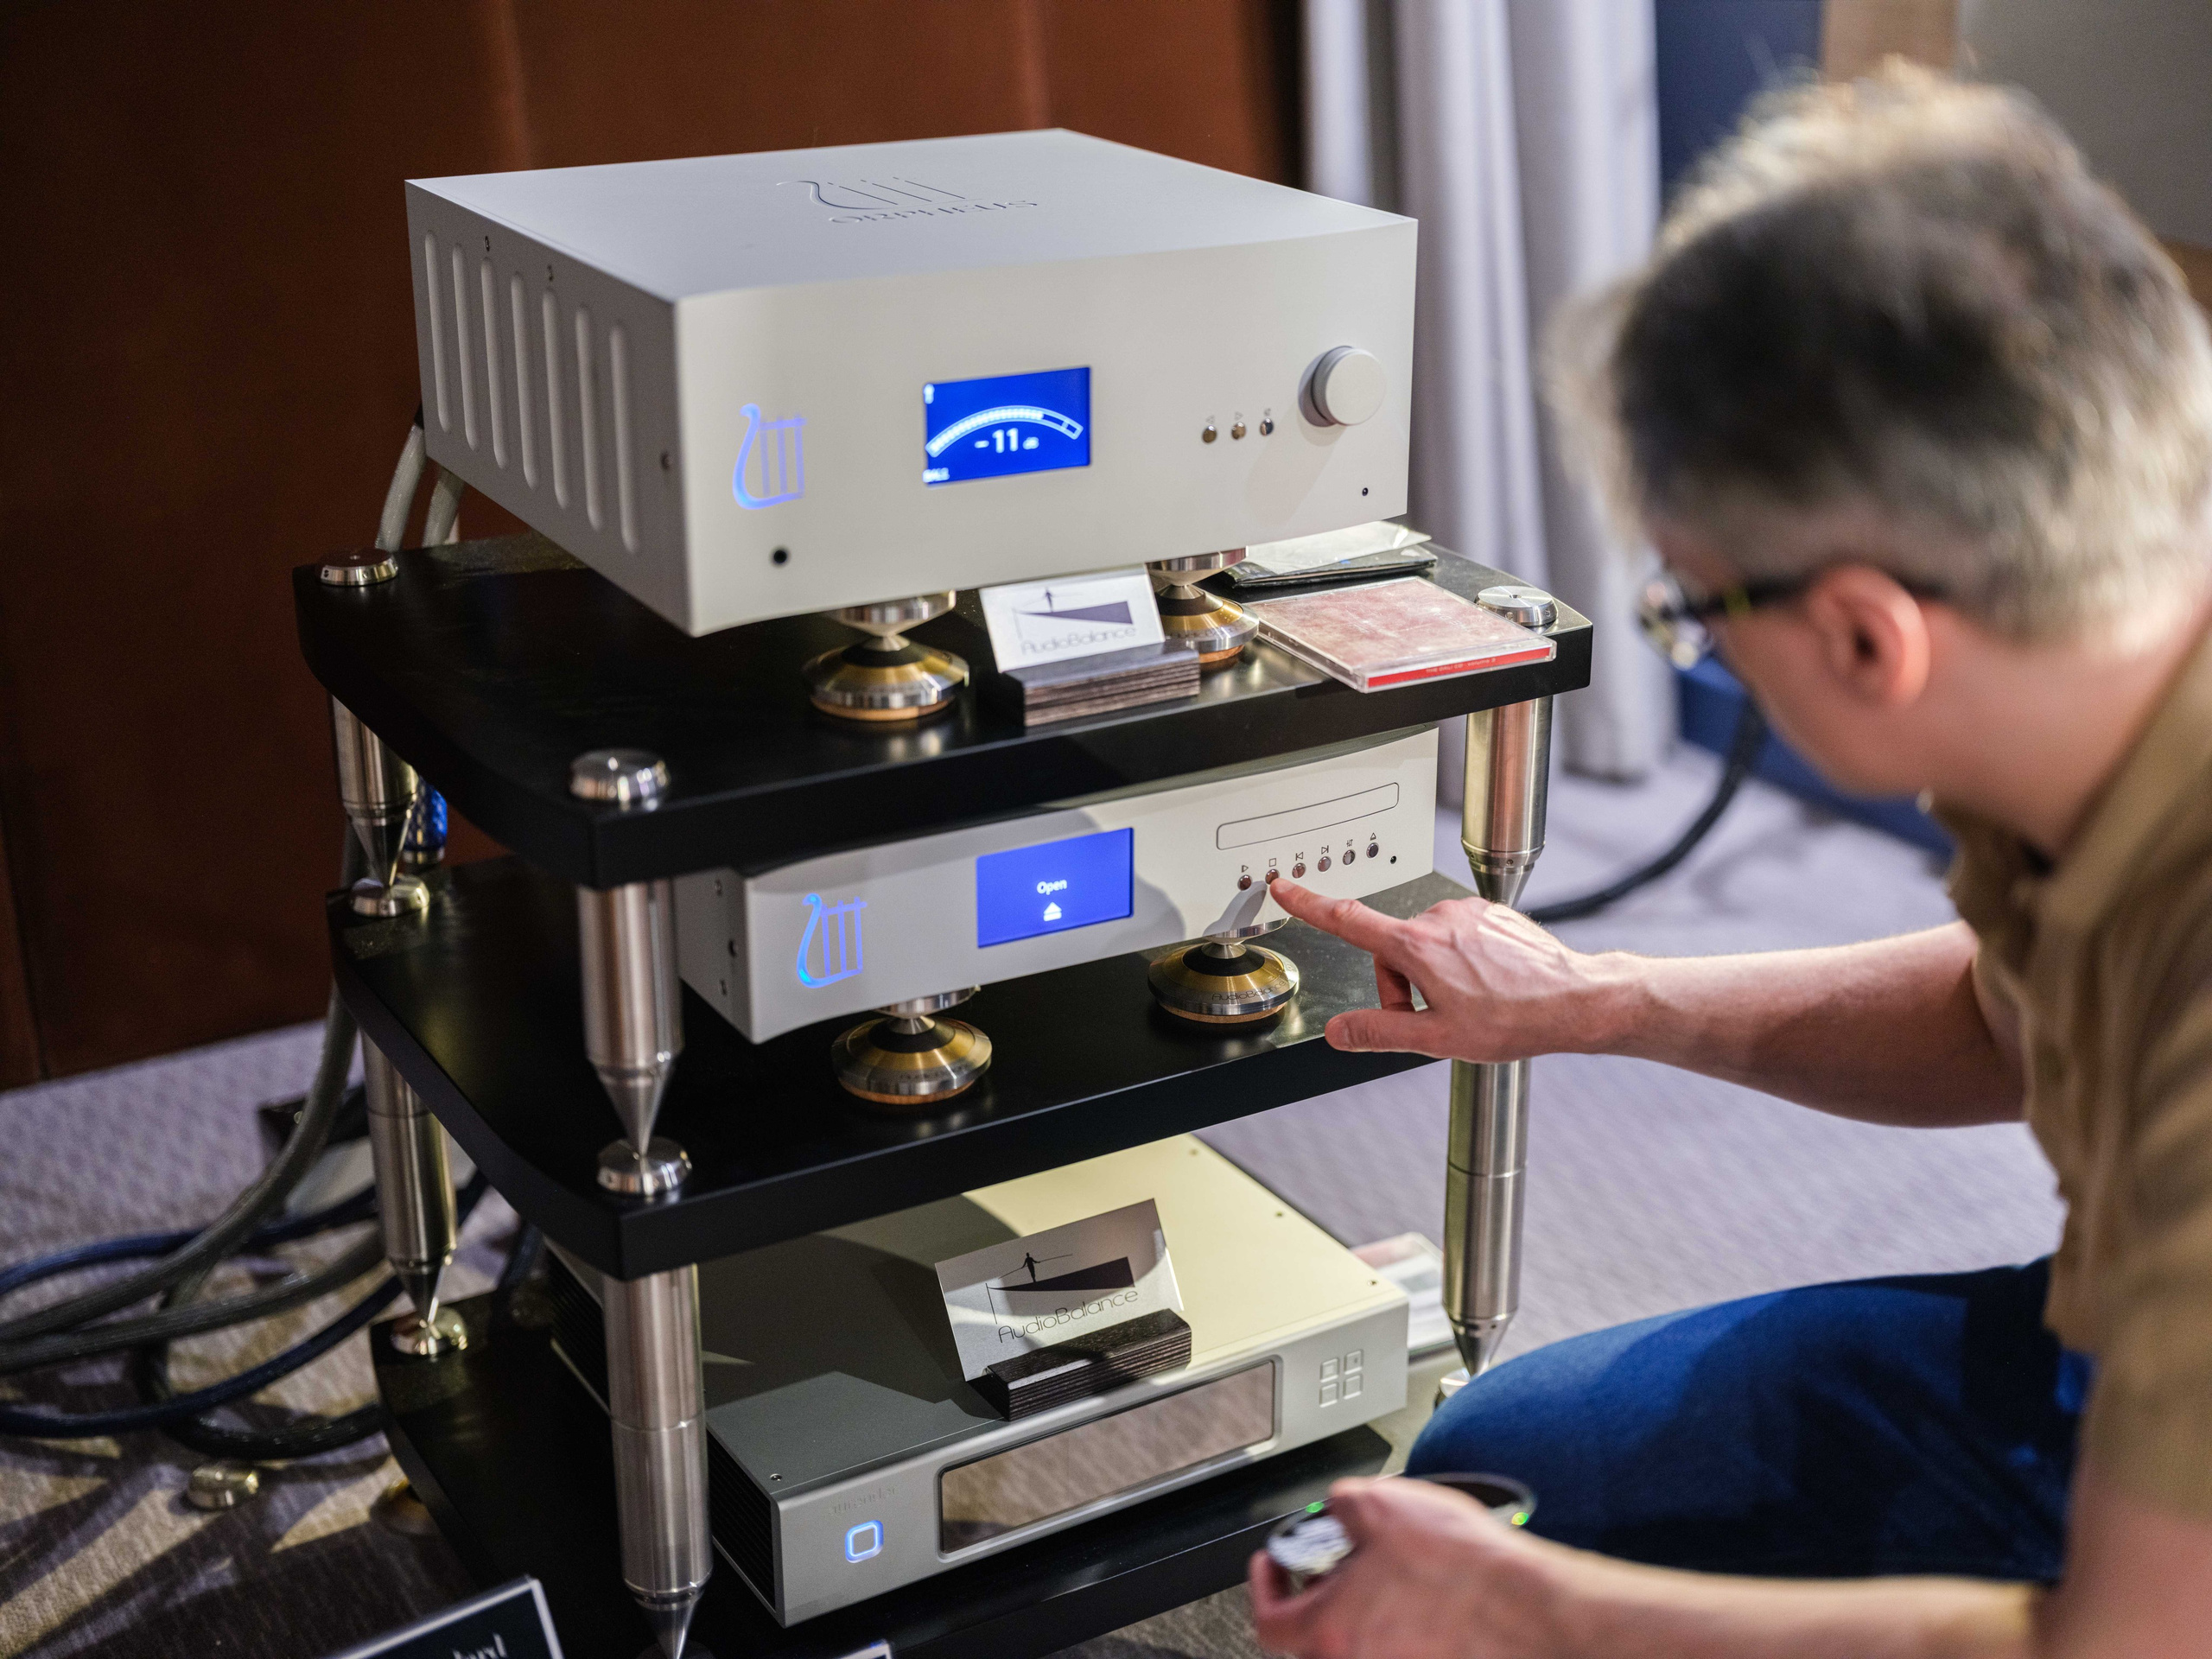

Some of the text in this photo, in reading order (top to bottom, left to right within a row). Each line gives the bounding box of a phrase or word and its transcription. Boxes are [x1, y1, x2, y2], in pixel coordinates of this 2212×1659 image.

[829, 200, 1037, 224] ORPHEUS
[975, 428, 1019, 454] -11
[1021, 627, 1136, 655] AudioBalance
[1036, 879, 1067, 896] Open
[1211, 981, 1286, 1001] AudioBalance
[998, 1291, 1139, 1344] AudioBalance
